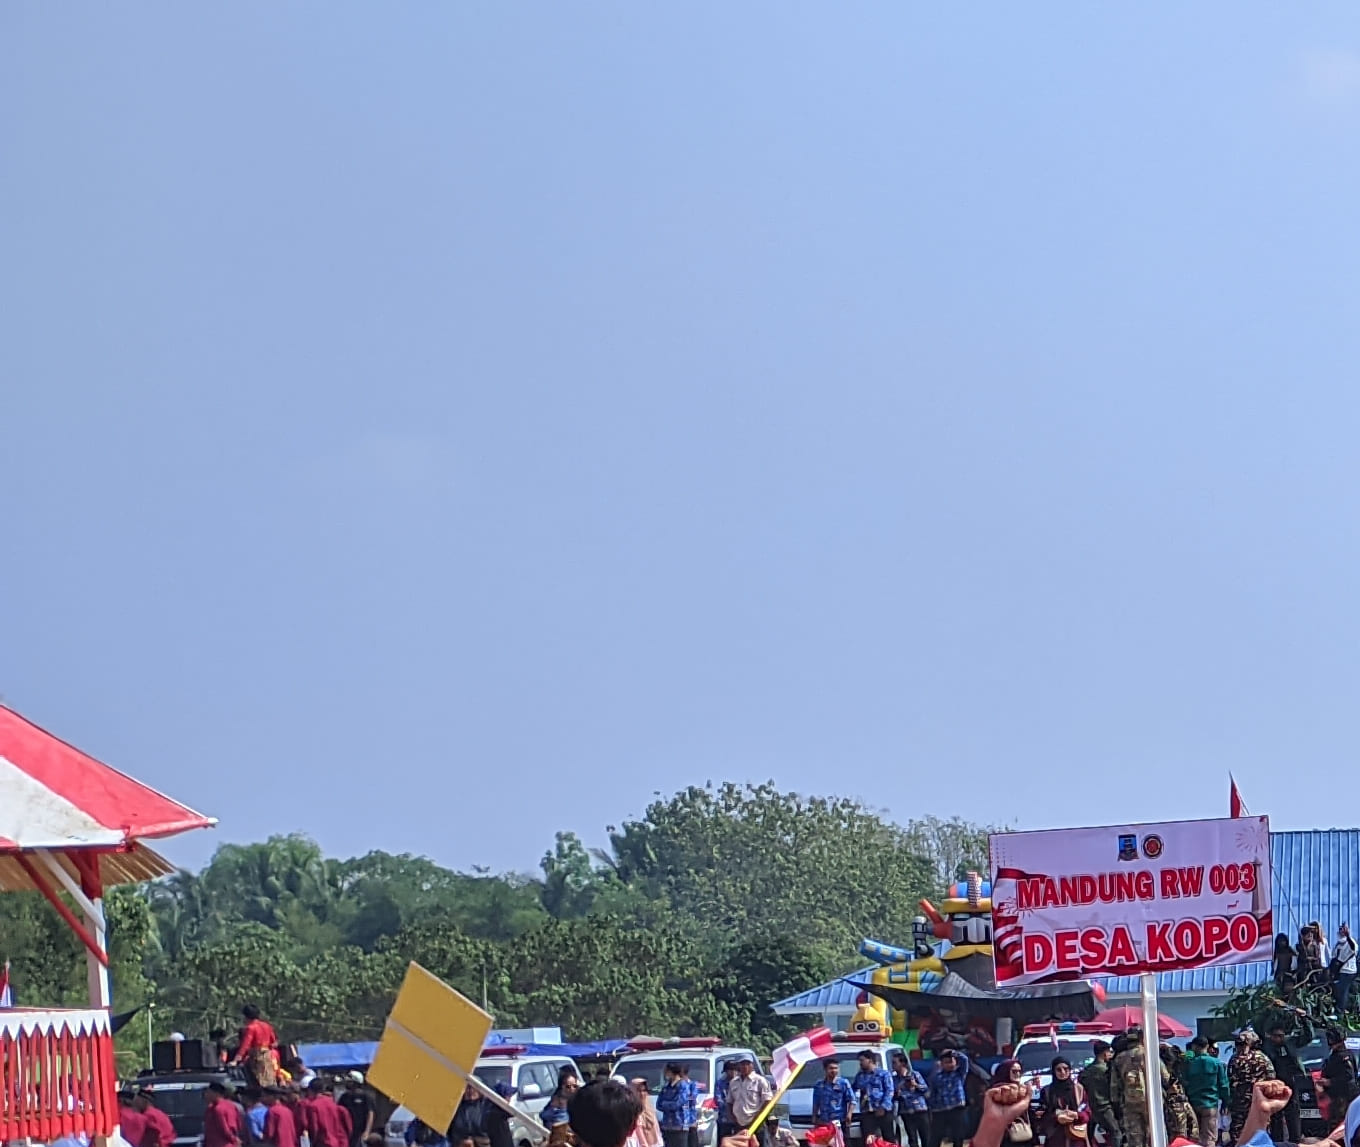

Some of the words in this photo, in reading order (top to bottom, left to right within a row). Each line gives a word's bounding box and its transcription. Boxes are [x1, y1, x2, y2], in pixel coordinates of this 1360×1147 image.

[1016, 871, 1154, 910] MANDUNG
[1160, 866, 1204, 898] RW
[1209, 862, 1257, 894] 003
[1022, 924, 1137, 973] DESA
[1147, 913, 1259, 962] KOPO
